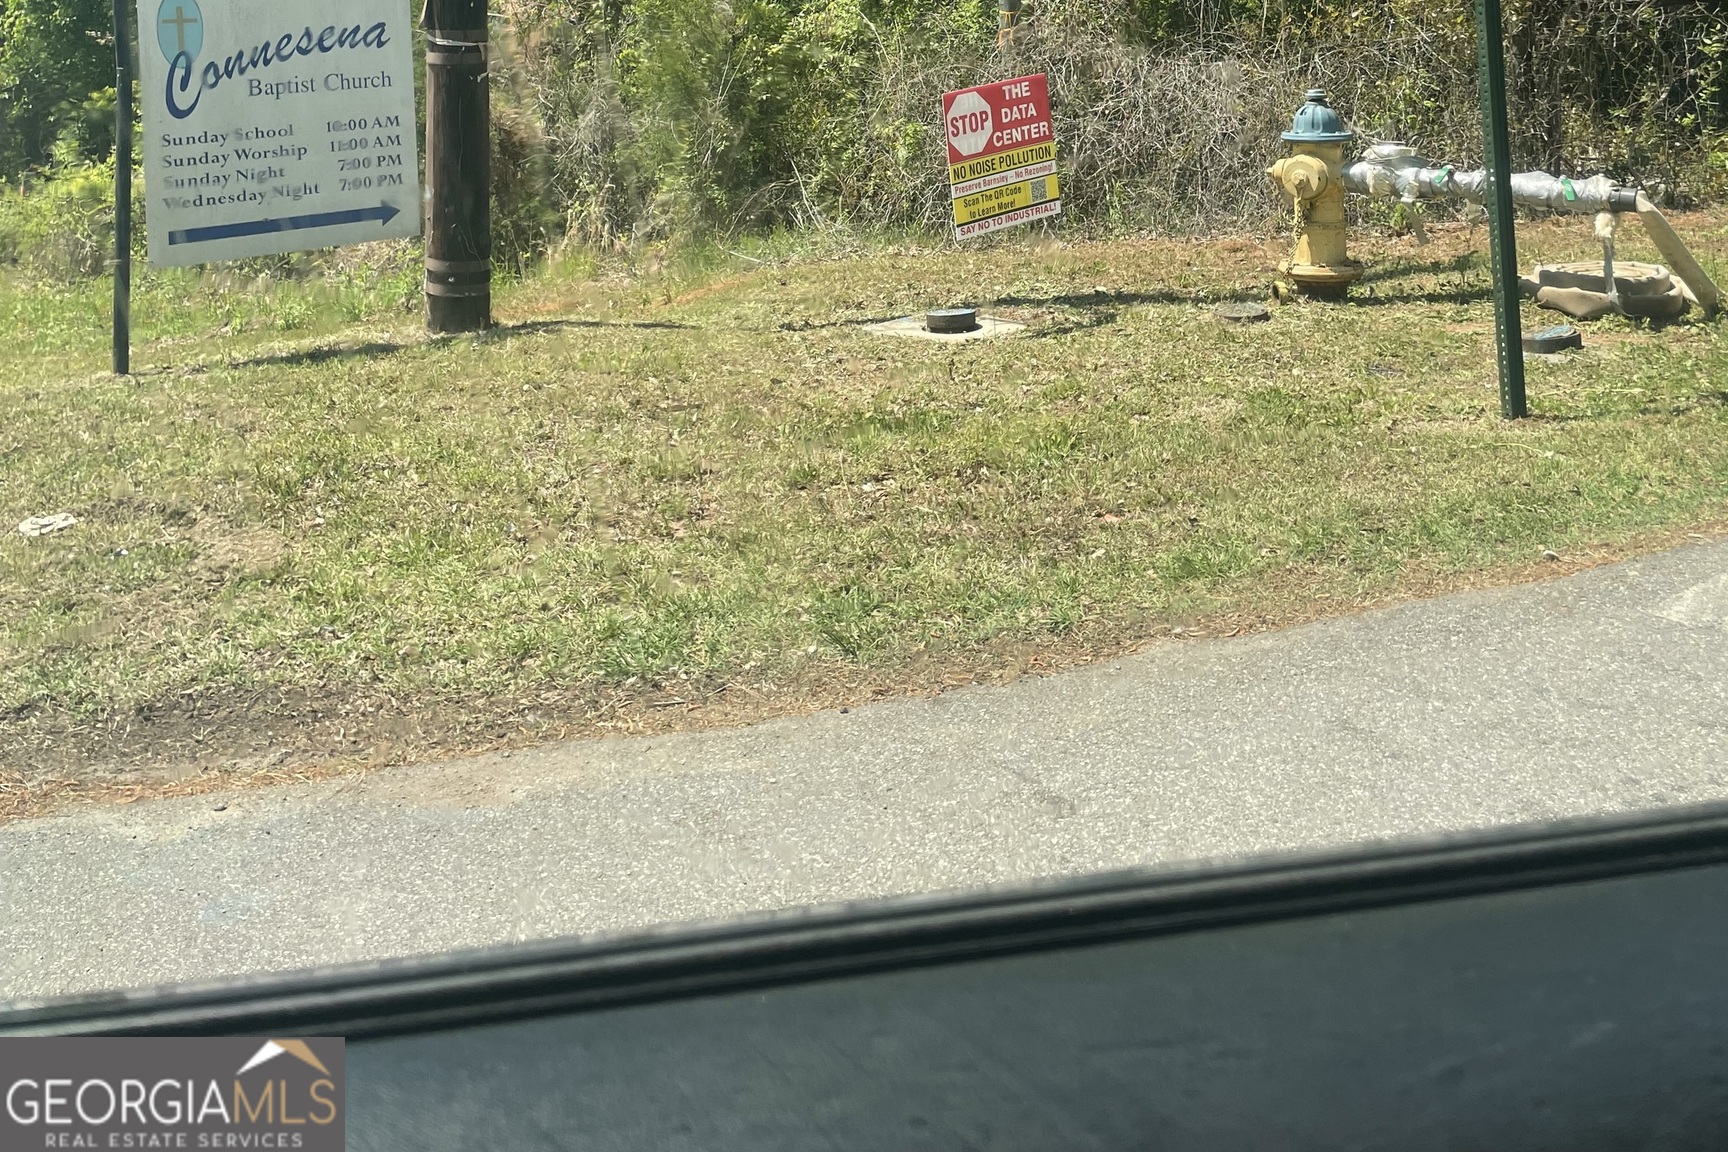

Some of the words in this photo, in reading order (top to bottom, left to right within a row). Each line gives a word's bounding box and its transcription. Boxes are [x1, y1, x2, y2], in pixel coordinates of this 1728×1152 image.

[165, 21, 391, 120] Connesena
[248, 75, 316, 100] Baptist
[323, 70, 393, 92] Church
[1001, 81, 1031, 101] THE
[950, 110, 989, 138] STOP
[1000, 102, 1038, 124] DATA
[162, 130, 229, 148] Sunday
[235, 123, 294, 142] School
[326, 118, 367, 133] 10:00
[372, 115, 400, 129] AM
[992, 121, 1050, 147] CENTER
[163, 151, 230, 168] Sunday
[233, 144, 308, 161] Worship
[330, 137, 369, 152] 11:00
[373, 134, 402, 148] AM
[953, 166, 967, 181] NO
[968, 158, 997, 177] NOISE
[998, 145, 1052, 169] POLLUTION
[163, 172, 231, 190] Sunday
[235, 166, 286, 184] Night
[338, 157, 372, 172] 7:00
[376, 153, 403, 168] PM
[954, 182, 982, 195] Preserve
[982, 174, 1009, 188] Barnsley
[1014, 170, 1024, 179] No
[1024, 162, 1053, 177] Rezoning!
[162, 189, 267, 209] Wednesday
[272, 181, 321, 202] Night
[339, 175, 372, 191] 7:00
[377, 172, 404, 188] PM
[963, 197, 980, 209] Scan
[980, 192, 993, 204] The
[994, 189, 1004, 200] QR
[1005, 185, 1022, 197] Code
[960, 224, 979, 236] SAY
[978, 219, 991, 231] NO
[991, 216, 1003, 227] TO
[1004, 202, 1057, 224] INDUSTRIAL!
[969, 210, 977, 220] to
[977, 204, 997, 217] Learn
[997, 199, 1016, 212] More!
